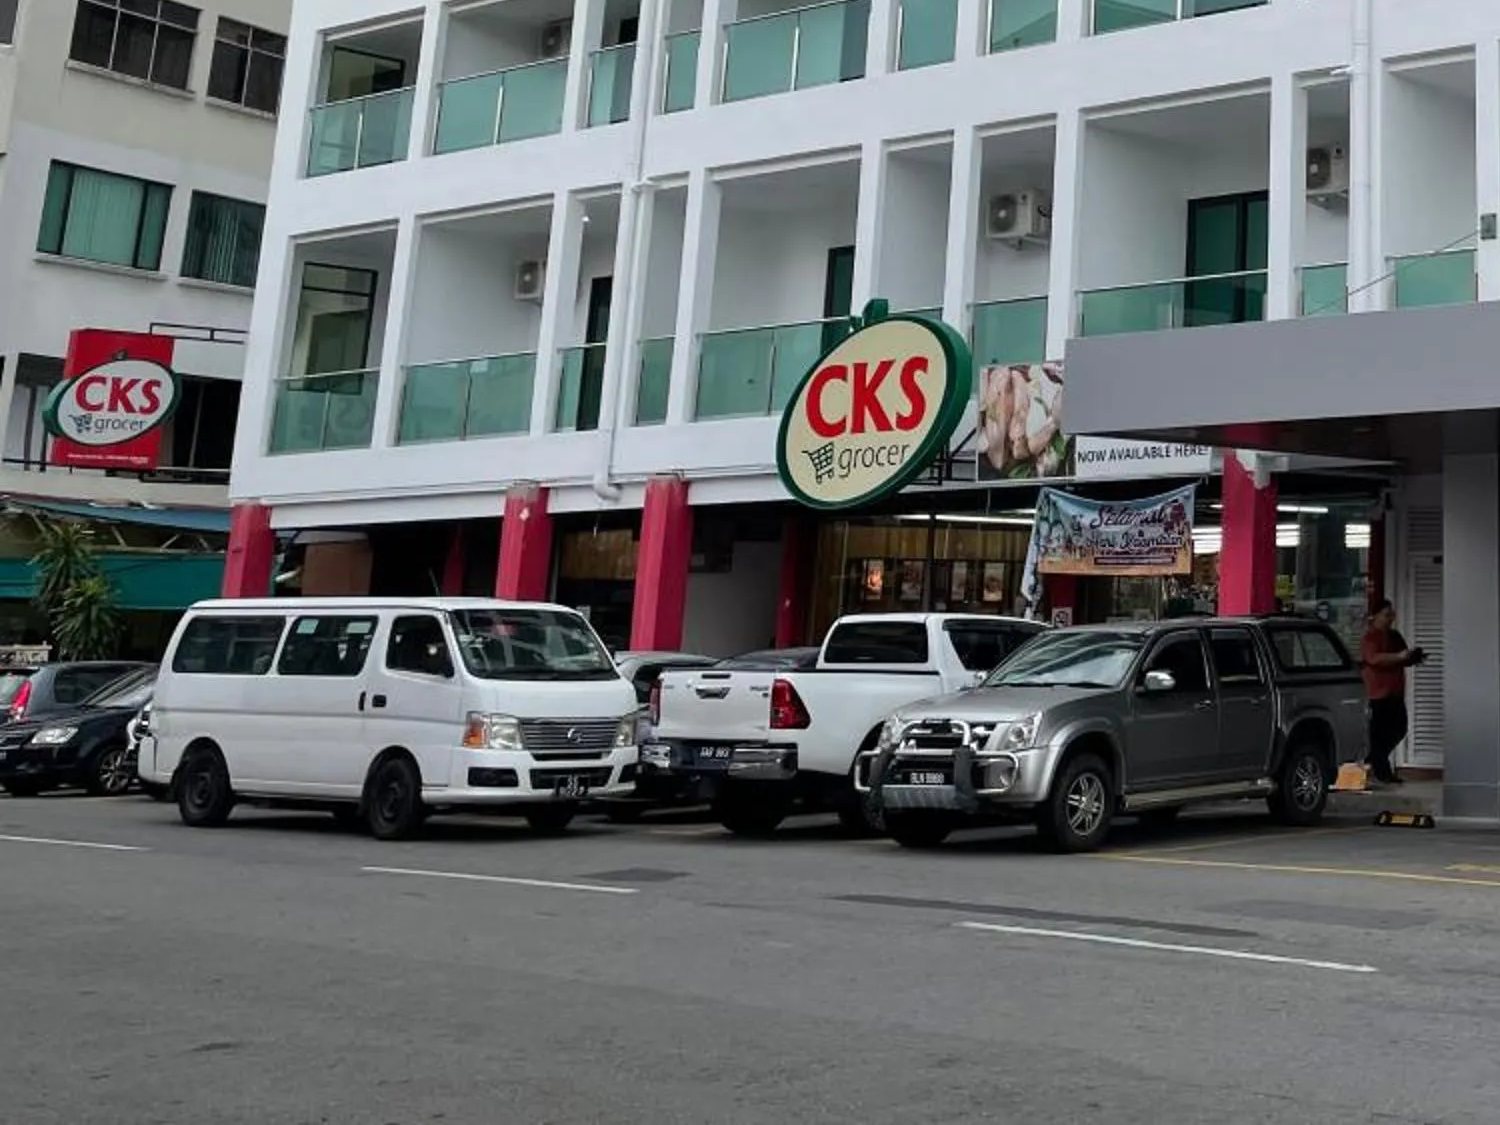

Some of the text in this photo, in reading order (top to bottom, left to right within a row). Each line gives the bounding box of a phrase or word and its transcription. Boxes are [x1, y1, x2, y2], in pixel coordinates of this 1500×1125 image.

[75, 375, 162, 416] CKS
[806, 355, 929, 438] CKS
[94, 417, 148, 434] grocer
[837, 443, 911, 478] grocer
[1077, 448, 1107, 464] NOW
[1109, 445, 1172, 462] AVAILABLE
